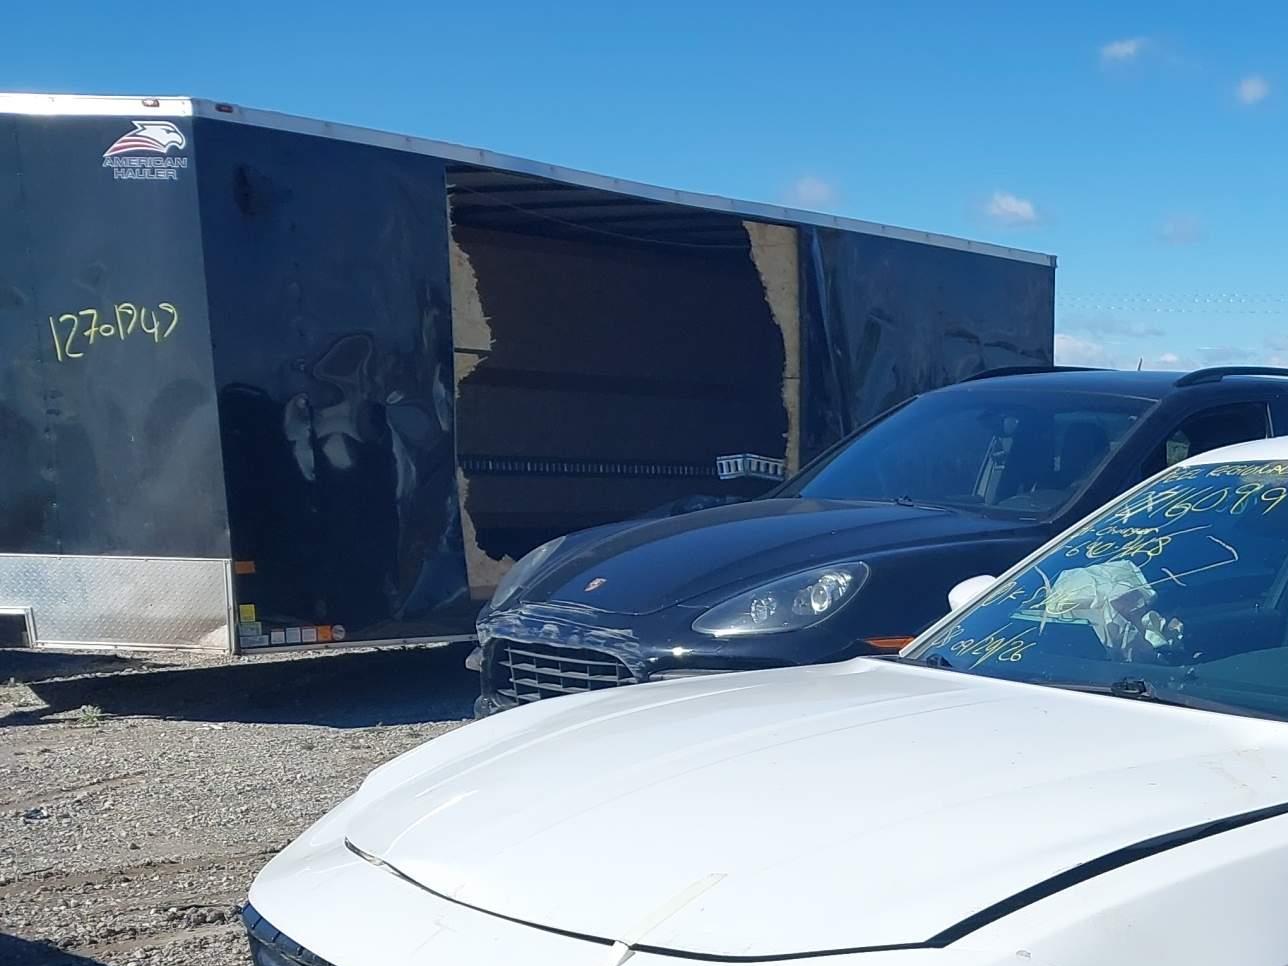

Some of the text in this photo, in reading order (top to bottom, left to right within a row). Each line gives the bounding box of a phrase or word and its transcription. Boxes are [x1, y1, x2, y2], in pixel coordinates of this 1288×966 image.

[102, 156, 189, 168] AMERICAN
[113, 167, 178, 180] HAULER
[950, 622, 1038, 670] 09/29/26
